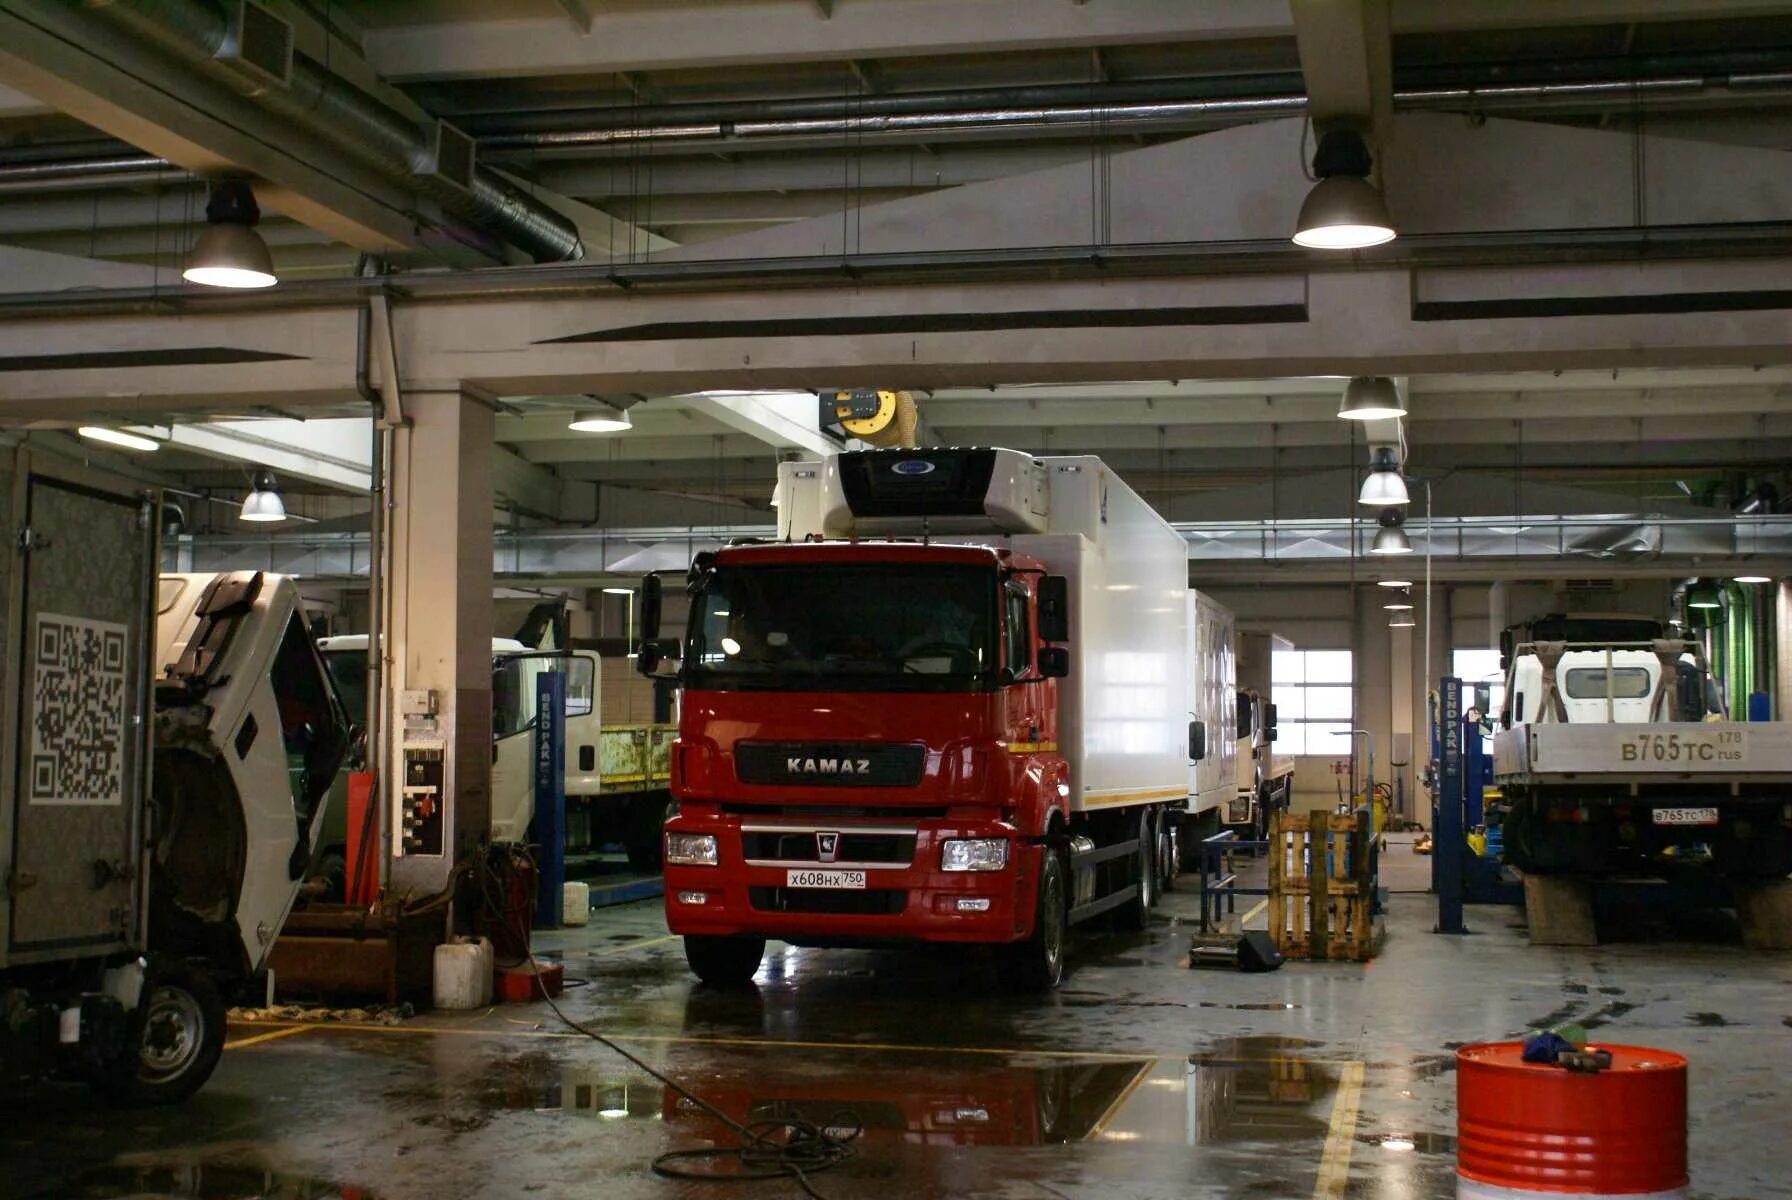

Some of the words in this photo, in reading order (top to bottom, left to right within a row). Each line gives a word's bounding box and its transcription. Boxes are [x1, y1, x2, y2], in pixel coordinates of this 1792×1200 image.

[1717, 731, 1742, 744] 178
[786, 758, 870, 774] KAMAZ
[842, 872, 862, 883] 750
